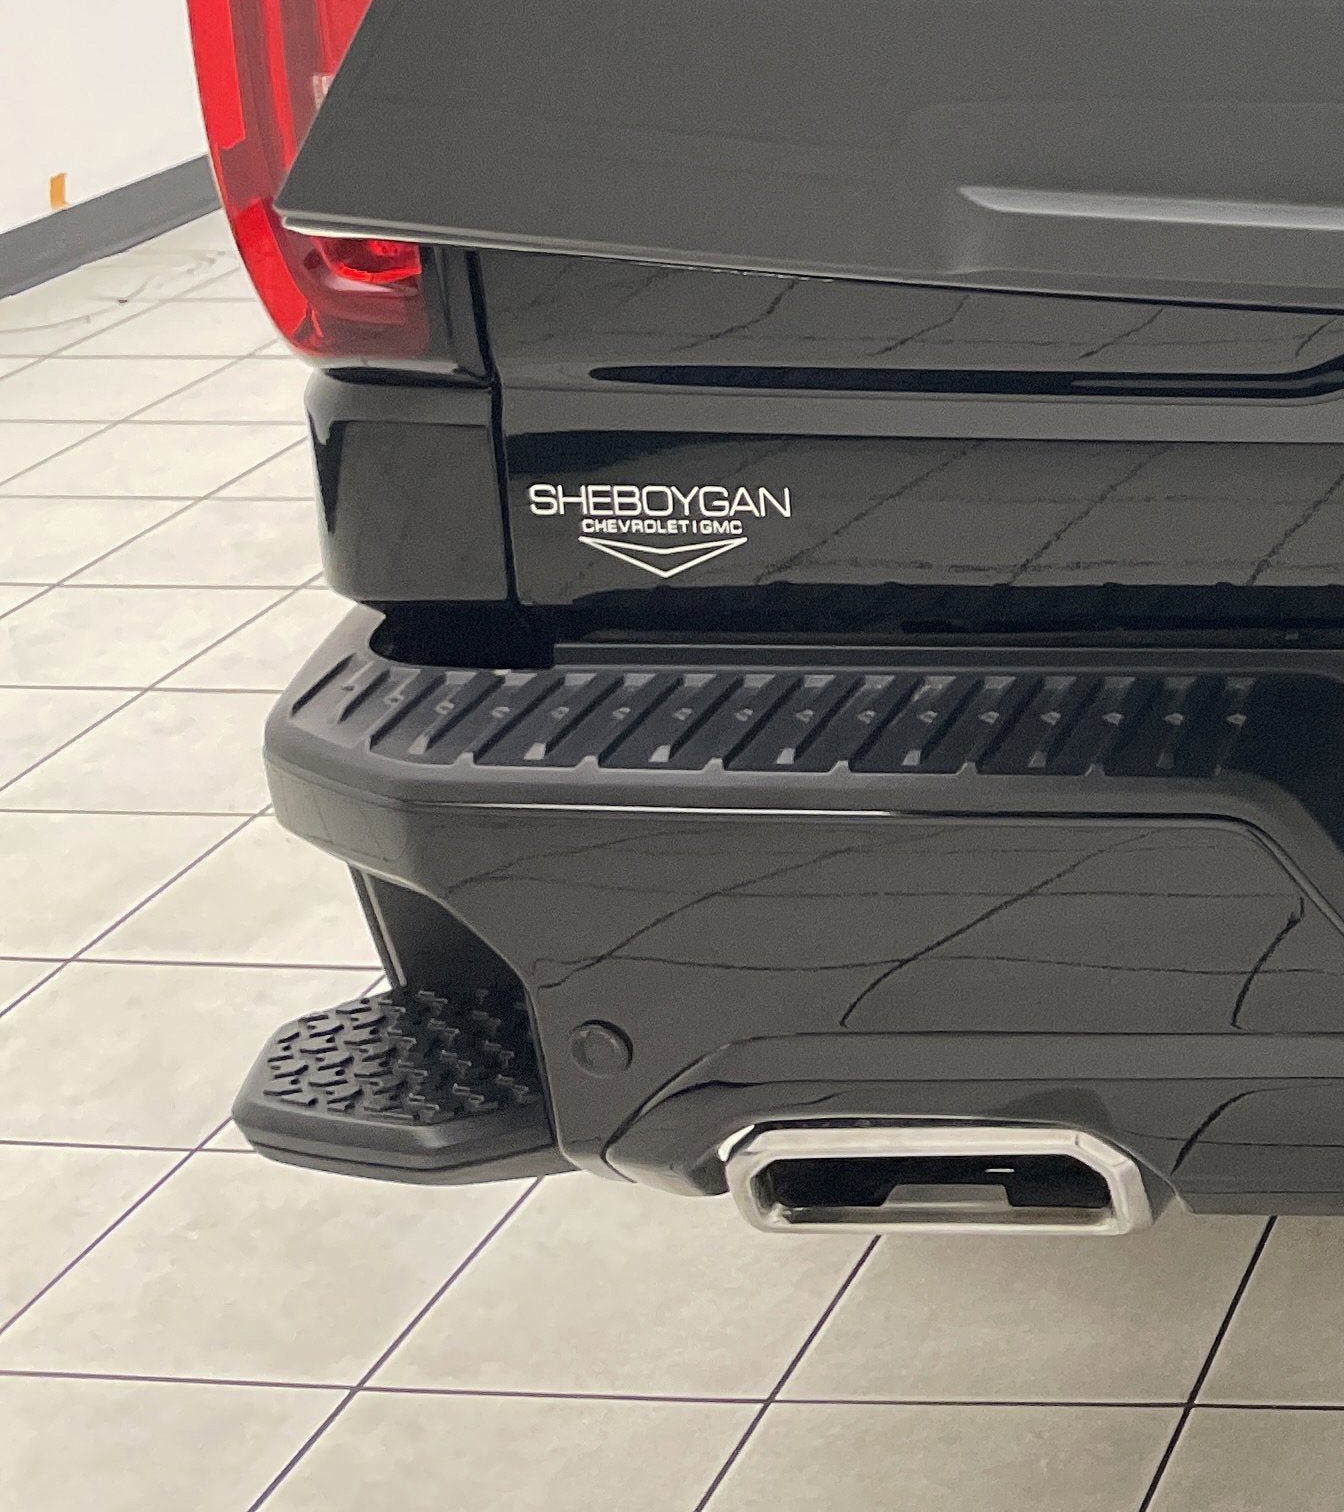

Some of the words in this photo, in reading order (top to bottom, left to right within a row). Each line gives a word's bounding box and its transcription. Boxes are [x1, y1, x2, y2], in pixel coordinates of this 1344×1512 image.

[528, 483, 791, 518] SHEBOYGAN
[580, 518, 690, 534] CHEVROLET
[699, 519, 743, 535] GMC
